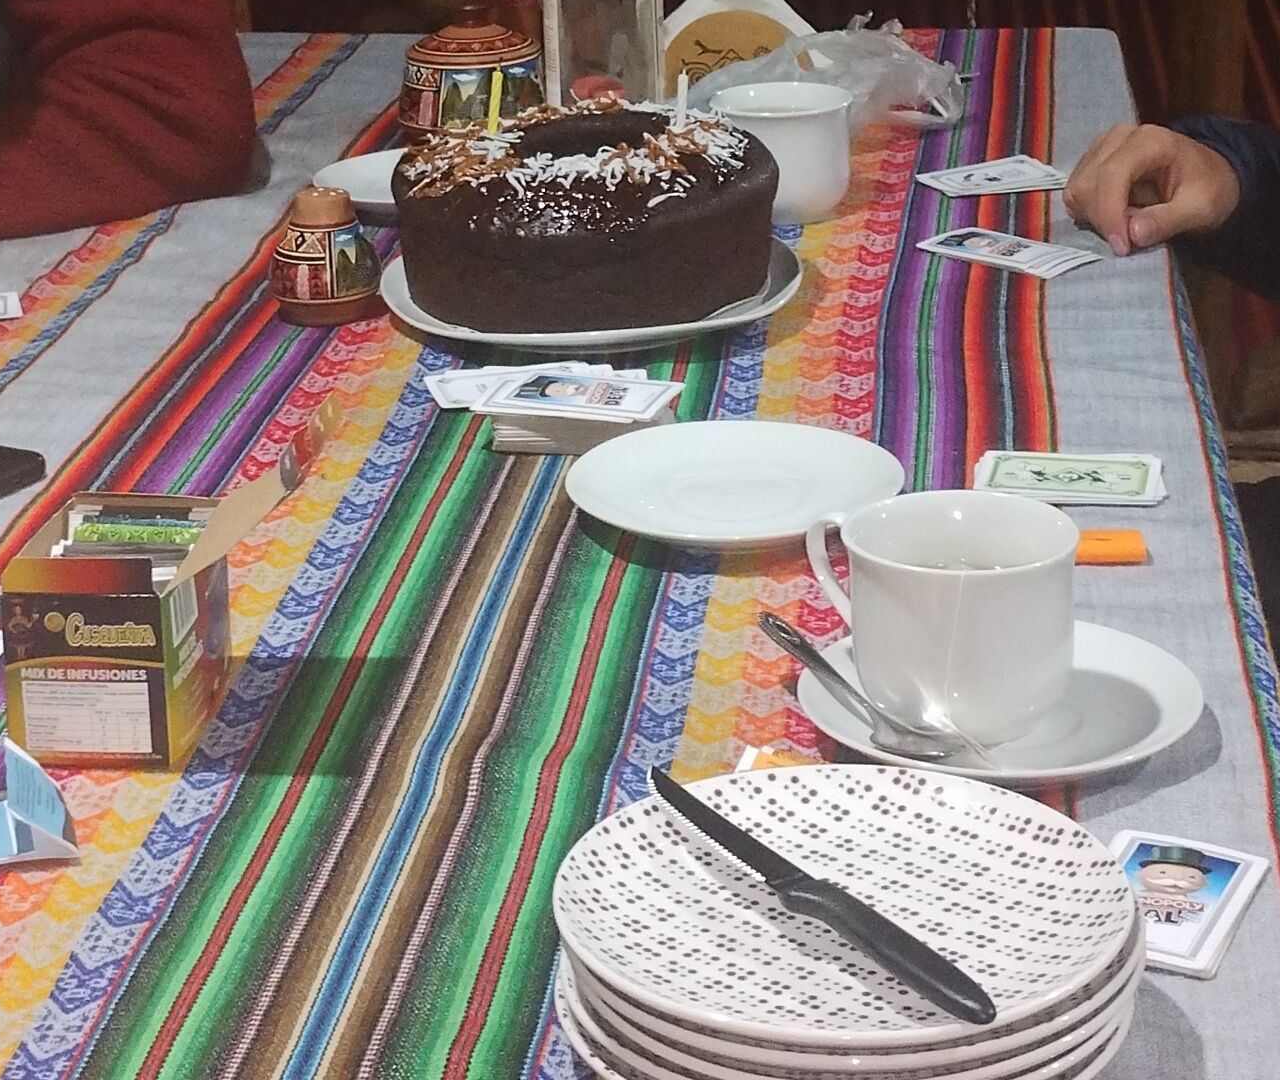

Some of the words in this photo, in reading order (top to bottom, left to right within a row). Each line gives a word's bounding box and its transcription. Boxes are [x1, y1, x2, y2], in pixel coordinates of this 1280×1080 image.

[21, 667, 46, 680] MIX
[47, 668, 66, 680] DE
[67, 668, 147, 681] INFUSIONES
[1139, 896, 1205, 912] NOPOLY
